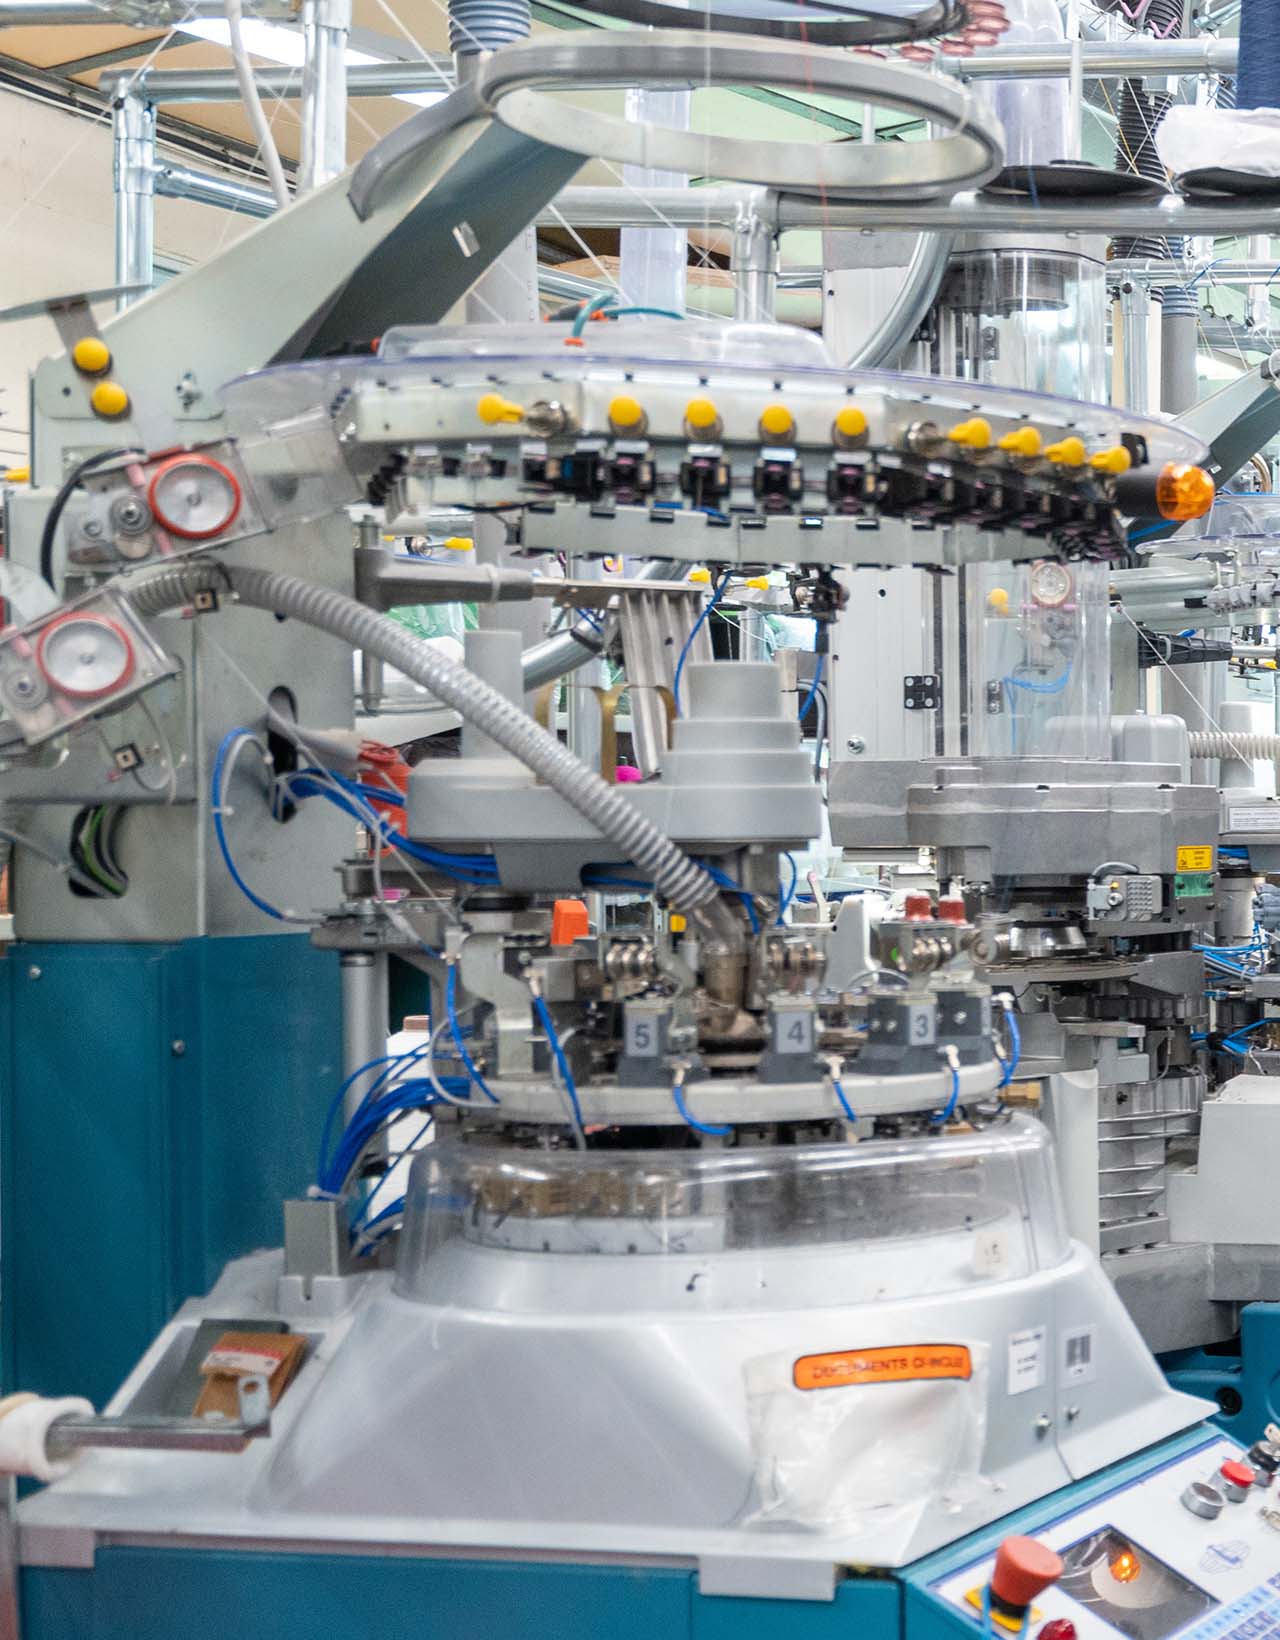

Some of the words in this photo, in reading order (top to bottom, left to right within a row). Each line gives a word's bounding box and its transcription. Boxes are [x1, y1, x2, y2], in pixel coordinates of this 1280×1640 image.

[634, 1024, 650, 1048] 5
[786, 1021, 805, 1045] 4
[914, 1014, 928, 1038] 3
